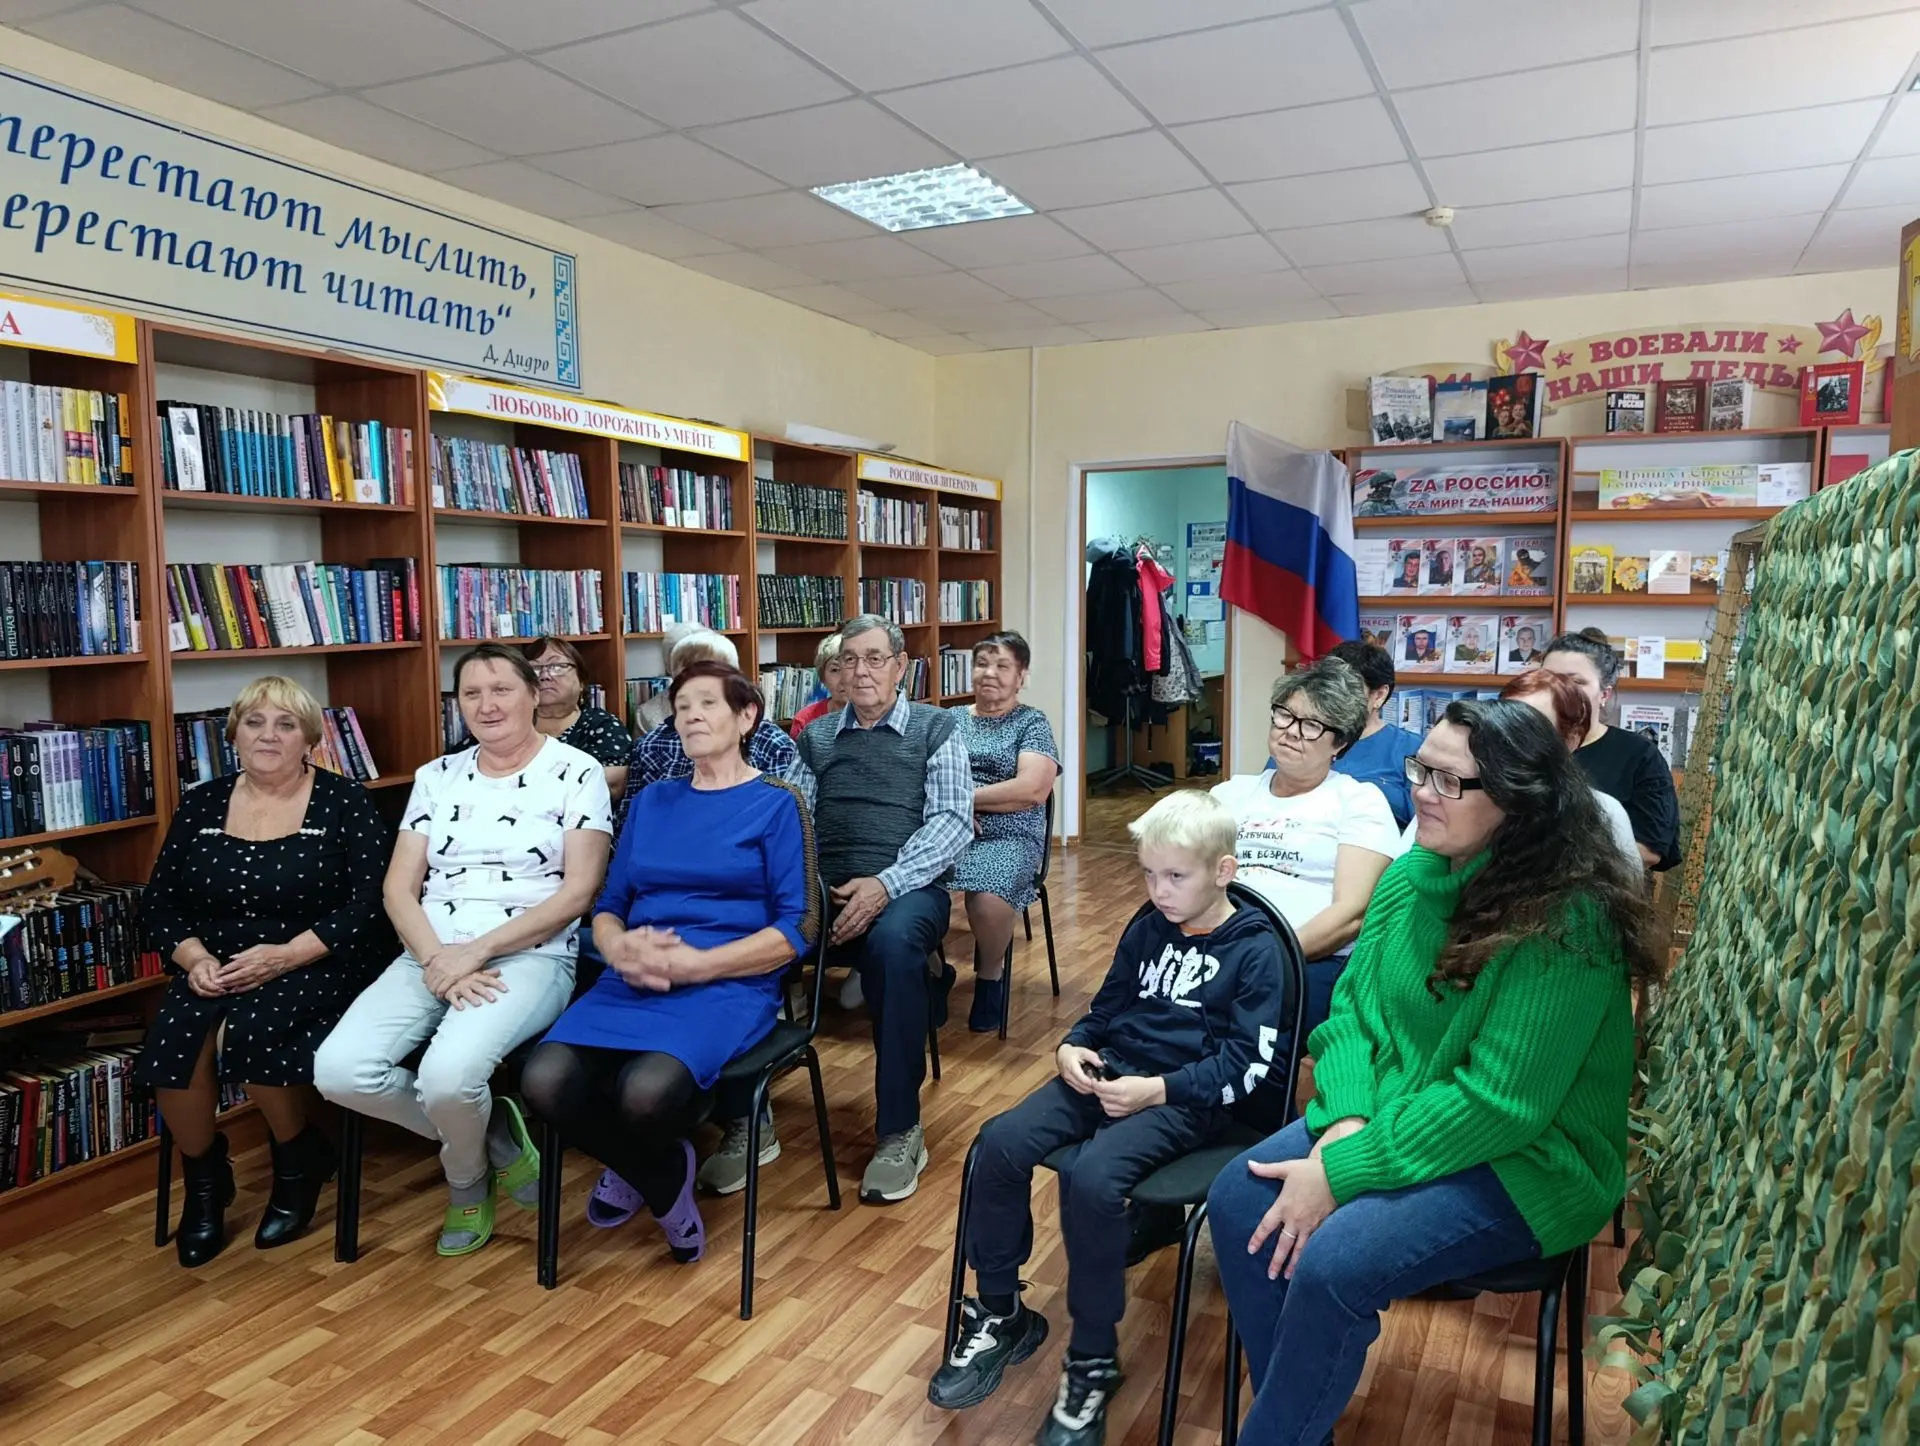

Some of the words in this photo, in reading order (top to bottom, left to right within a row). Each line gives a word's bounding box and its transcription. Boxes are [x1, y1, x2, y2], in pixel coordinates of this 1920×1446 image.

[2, 193, 307, 293] ерестают
[335, 217, 536, 299] мыслить,
[503, 348, 549, 375] Дидро
[1589, 330, 1769, 363] ВОЕВАЛИ
[1545, 362, 1664, 402] НАШИ
[486, 392, 579, 425] ЛЮБОВЬЮ
[582, 410, 660, 440] ДОРОЖИТЬ
[663, 425, 716, 450] УМЕЙТЕ
[889, 466, 939, 486] РОССИЙСКАЯ
[940, 475, 978, 492] ЛИТЕРАТУРА
[1445, 474, 1551, 493] РОССИЮ!
[1430, 499, 1463, 509] МИР!
[1491, 495, 1550, 508] НАШИХ!
[6, 615, 19, 657] СПЕЦНАЗ
[1237, 830, 1284, 840] БАБУШКА
[1242, 850, 1252, 859] НЕ
